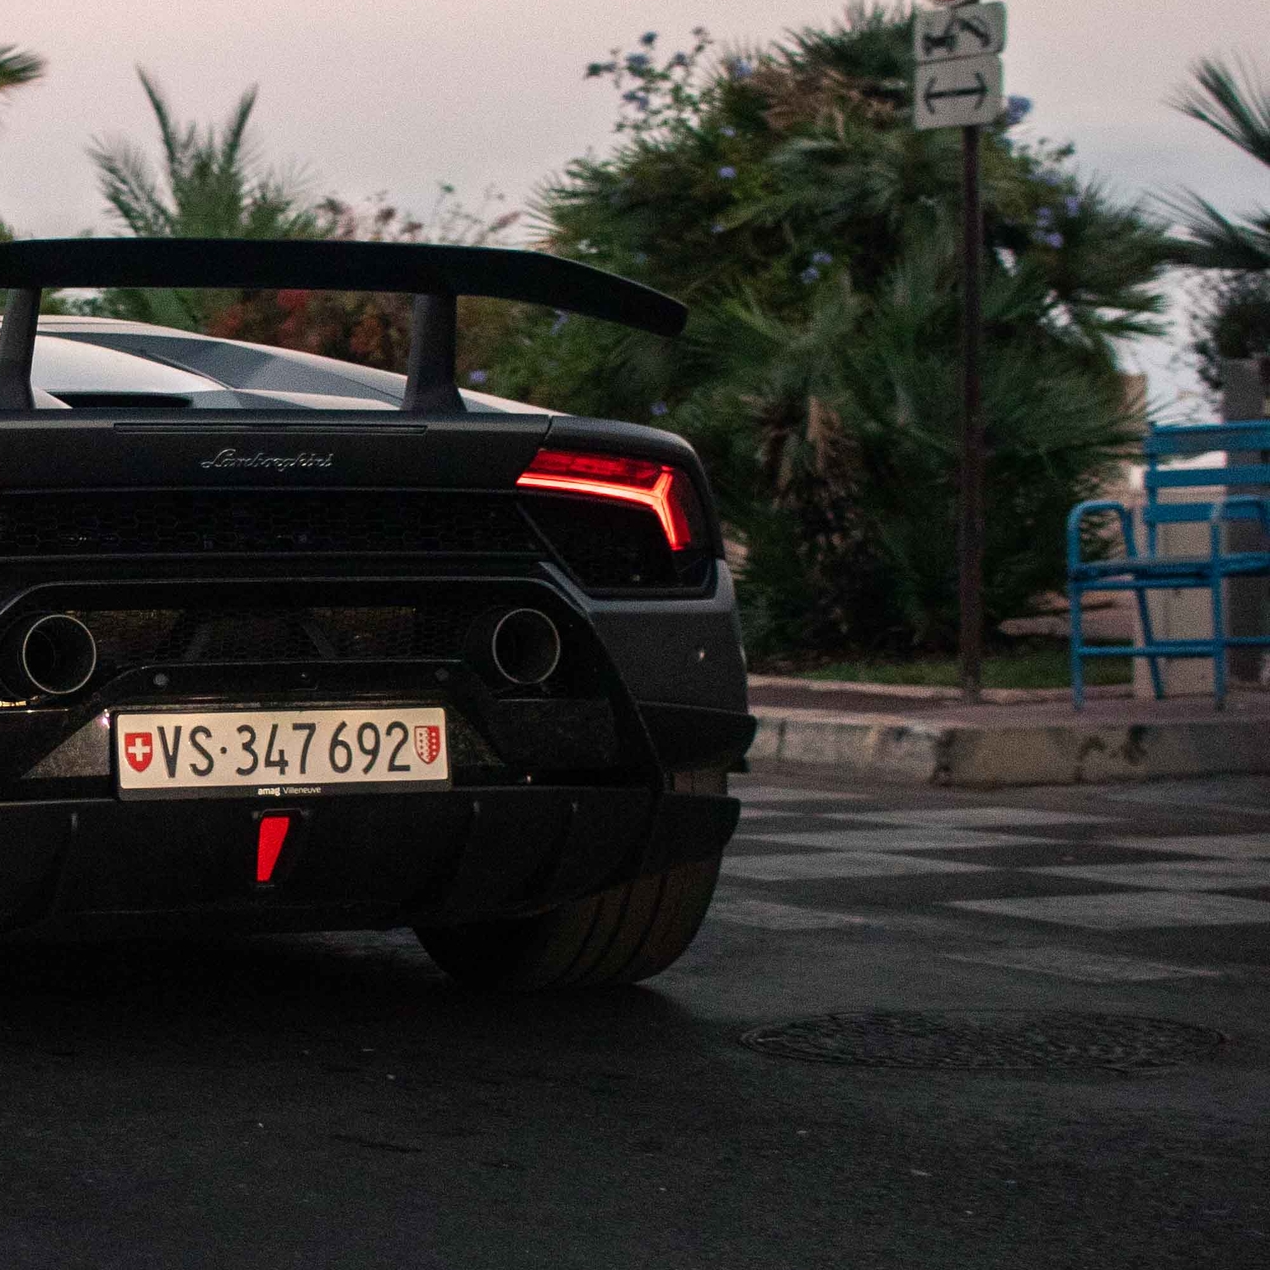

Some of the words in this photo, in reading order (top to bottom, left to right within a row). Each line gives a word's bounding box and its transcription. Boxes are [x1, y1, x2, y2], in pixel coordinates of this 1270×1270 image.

[201, 448, 333, 472] Lamborghini
[257, 786, 281, 797] amag
[282, 786, 322, 795] Villeneuve
